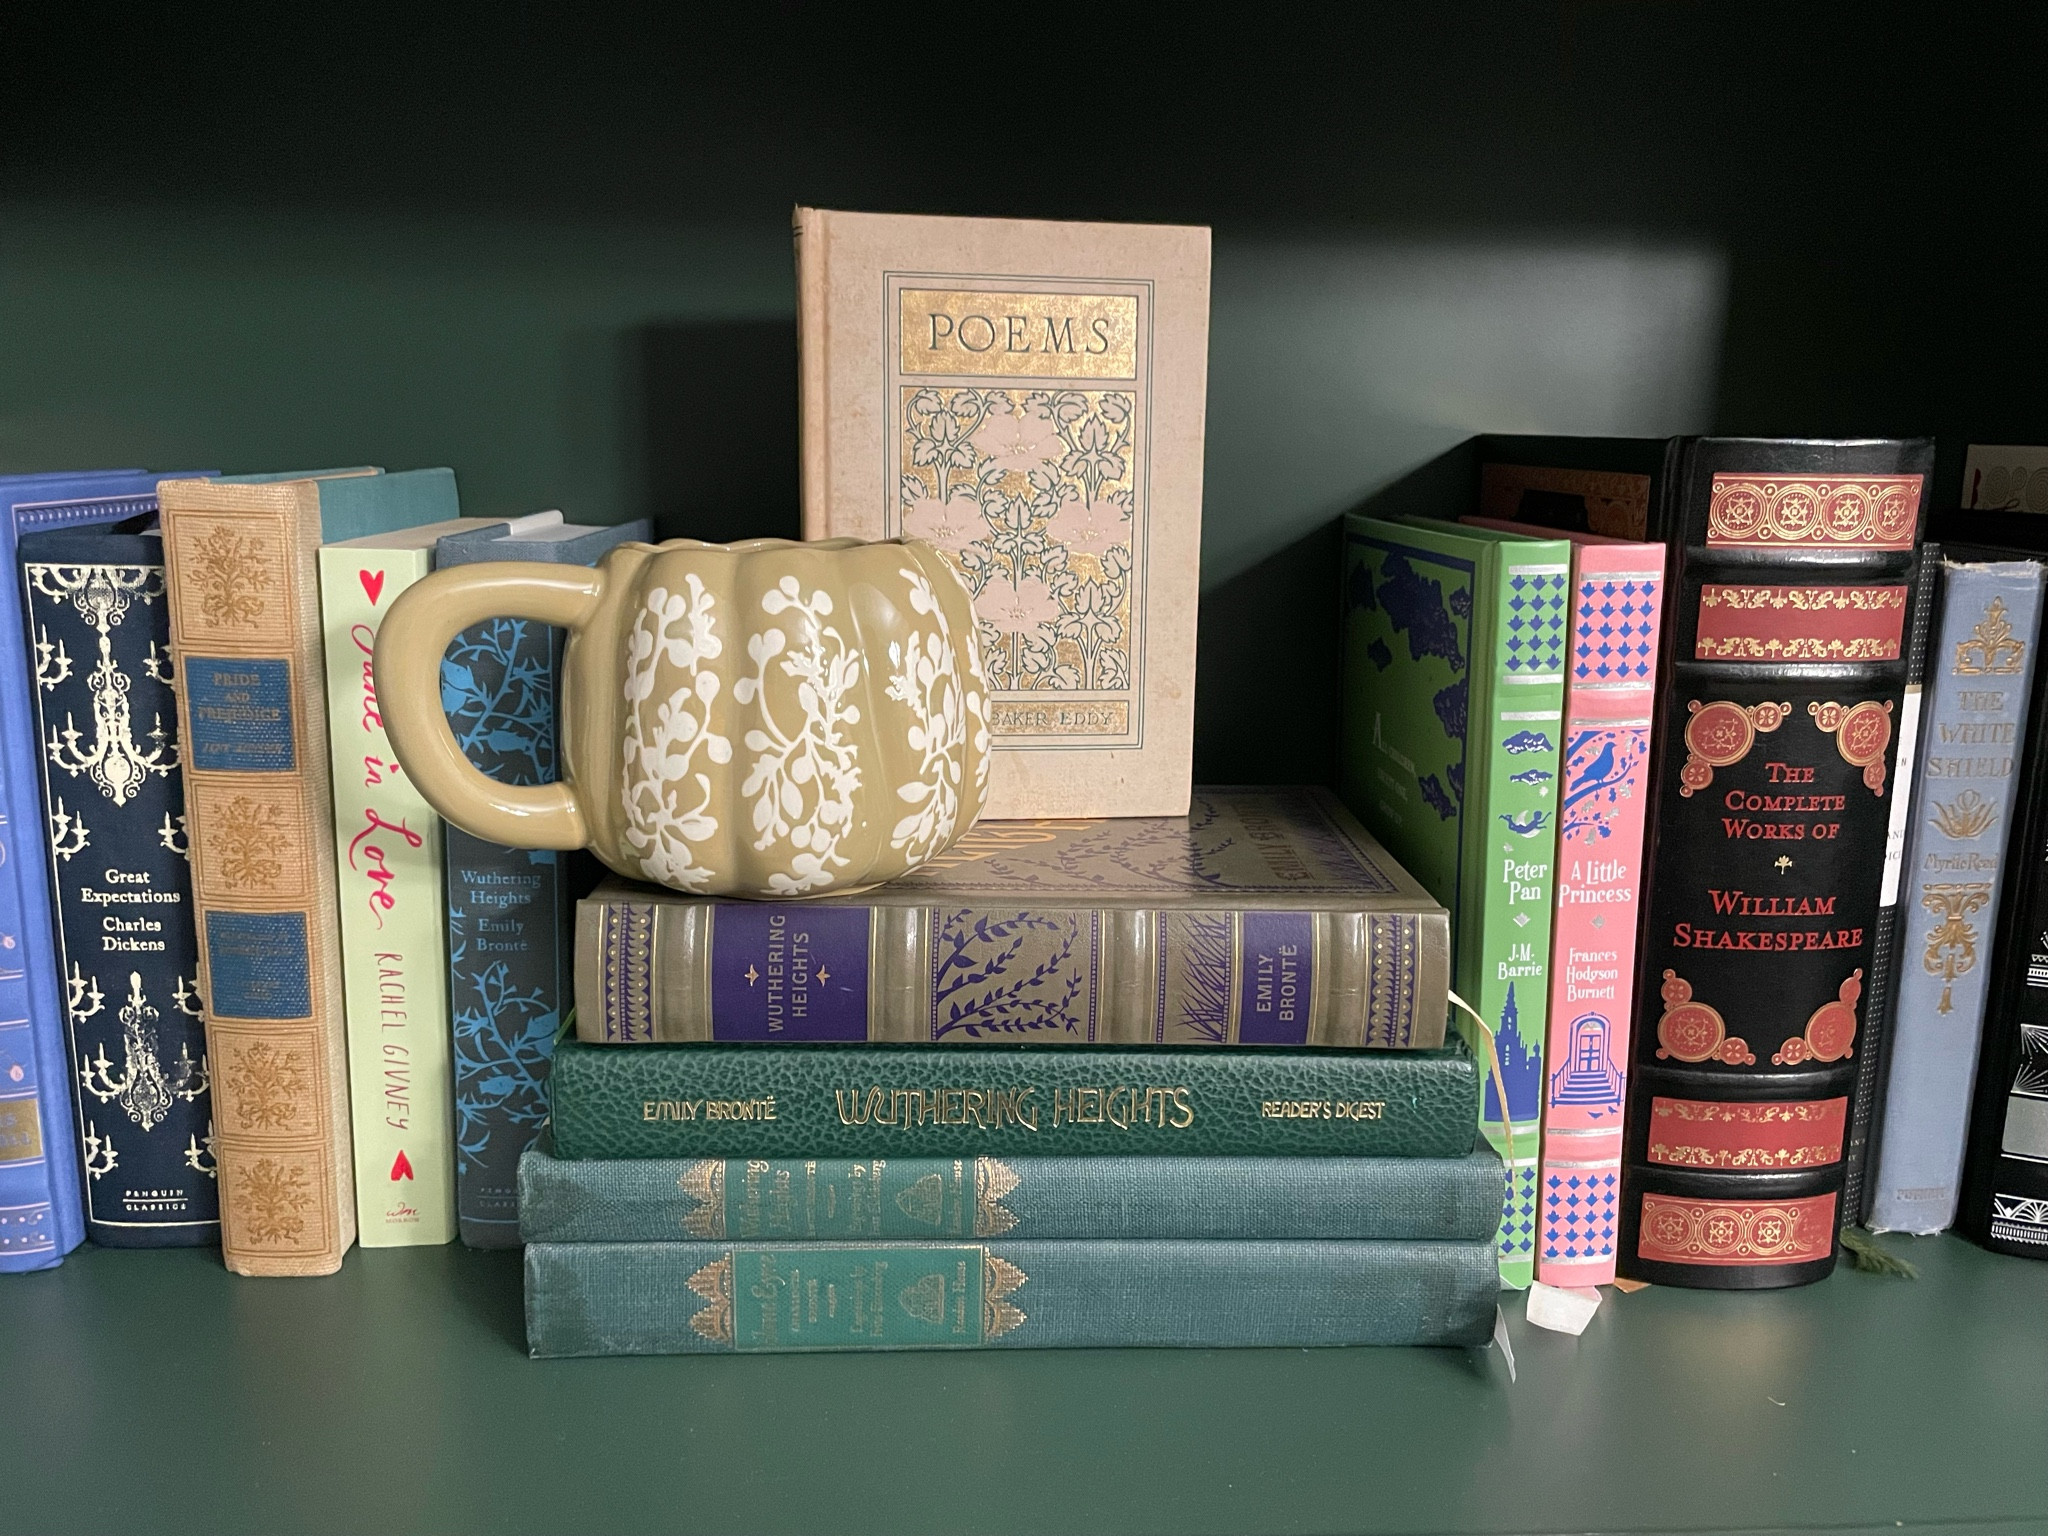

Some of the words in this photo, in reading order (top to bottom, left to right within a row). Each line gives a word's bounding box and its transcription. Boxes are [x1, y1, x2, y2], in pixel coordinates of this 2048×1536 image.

[928, 313, 1110, 354] POEMS
[212, 672, 261, 687] PRIDE
[1958, 691, 2004, 712] THE
[992, 711, 1048, 726] BAKER
[1060, 711, 1113, 726] EDDY
[1939, 722, 2016, 745] WHITE
[364, 756, 399, 788] in
[1764, 763, 1815, 783] THE
[1926, 757, 2014, 778] SHIELD
[1725, 790, 1846, 811] COMPLETE
[1721, 818, 1804, 840] WORKS
[1812, 824, 1840, 840] OF
[105, 868, 150, 884] Great
[348, 808, 422, 930] Love
[461, 869, 541, 888] Wuthering
[1503, 859, 1548, 883] Peter
[1571, 861, 1581, 880] A
[1586, 859, 1627, 884] Little
[81, 887, 181, 907] Expectations
[470, 890, 532, 909] Heights
[1509, 881, 1541, 905] Pan
[1558, 884, 1632, 908] Princess
[1708, 890, 1837, 916] WILLIAM
[102, 916, 162, 932] Charles
[478, 918, 525, 936] Emily
[101, 936, 166, 951] Dickens
[1673, 923, 1863, 951] SHAKESPEARE
[1568, 947, 1618, 965] Frances
[767, 915, 786, 1033] WUTHERING
[791, 932, 809, 1018] HEIGHTS
[1498, 961, 1543, 980] Barrie
[1566, 965, 1618, 984] Hodgson
[374, 953, 407, 1034] RACHEL
[1256, 953, 1273, 1012] EMILY
[1278, 944, 1297, 1021] BRONTË
[1567, 984, 1615, 1002] Burnett
[382, 1044, 411, 1130] GIVNEY
[643, 1099, 703, 1121] EMILY
[705, 1095, 777, 1121] BRONTË
[835, 1085, 1038, 1131] WUTHERING
[1052, 1085, 1195, 1130] HEIGHTS
[1261, 1100, 1332, 1120] READER'S
[1335, 1101, 1386, 1121] DIGEST
